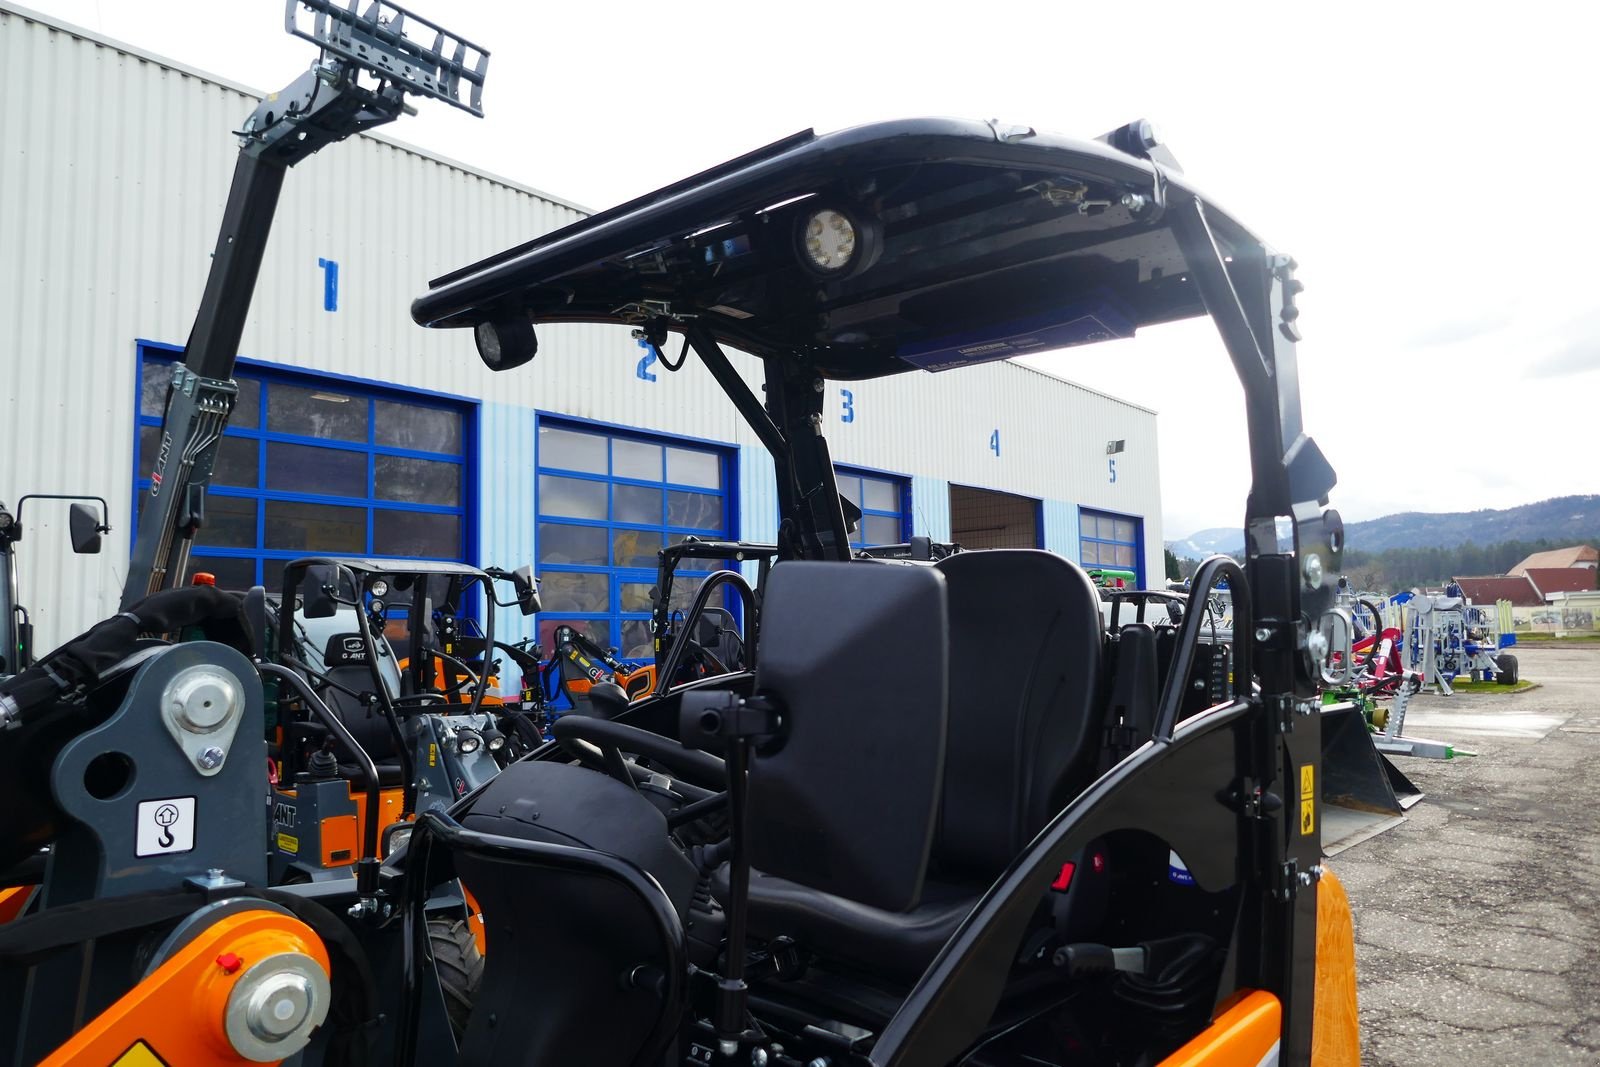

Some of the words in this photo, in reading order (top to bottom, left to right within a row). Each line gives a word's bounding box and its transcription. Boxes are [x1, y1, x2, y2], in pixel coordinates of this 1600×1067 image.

[318, 257, 338, 312] 1
[636, 338, 657, 383] 2
[840, 388, 854, 424] 3
[990, 429, 1000, 457] 4
[151, 431, 172, 497] GIANT
[1109, 458, 1116, 483] 5
